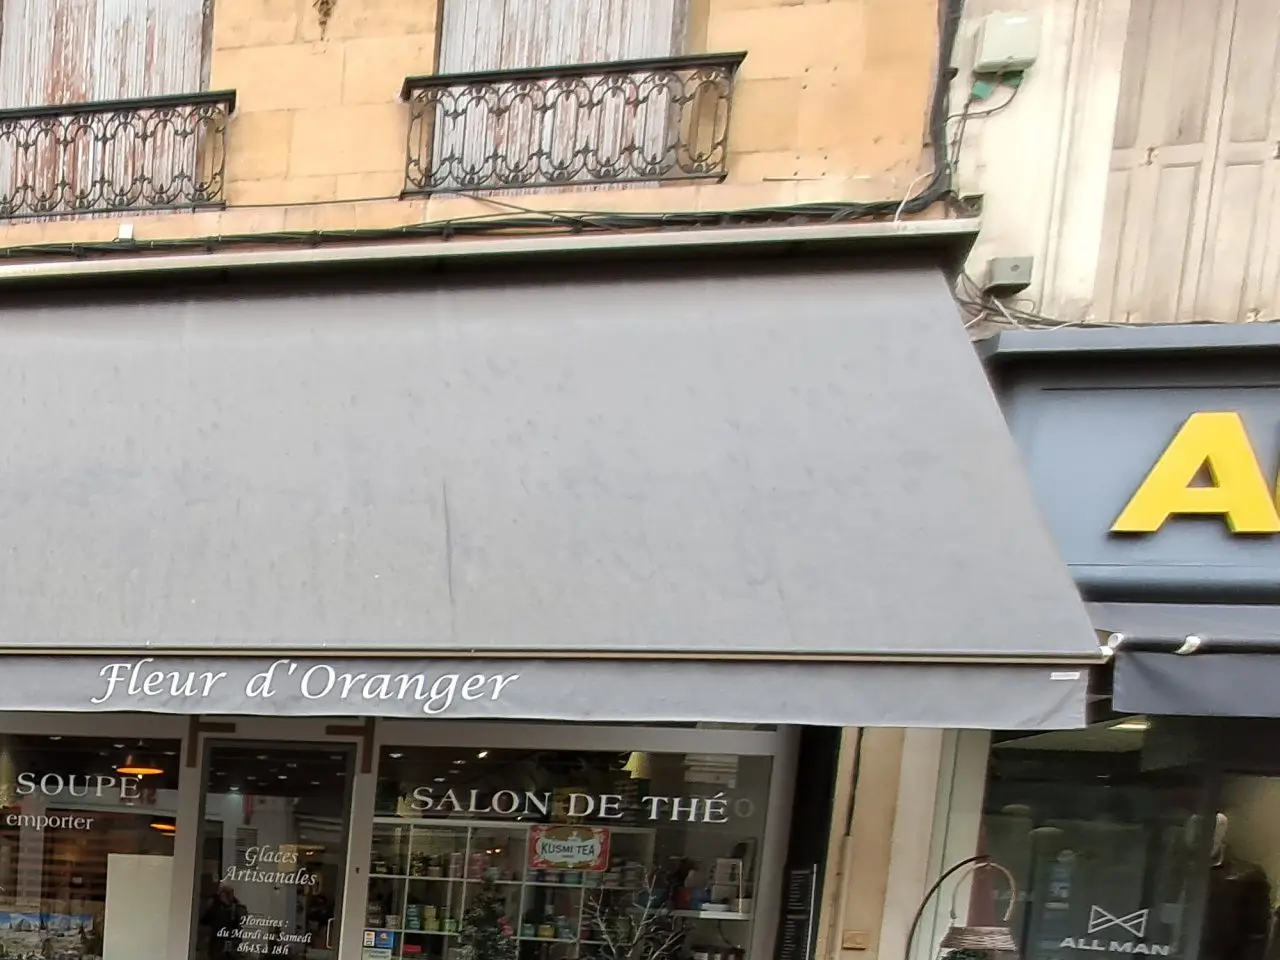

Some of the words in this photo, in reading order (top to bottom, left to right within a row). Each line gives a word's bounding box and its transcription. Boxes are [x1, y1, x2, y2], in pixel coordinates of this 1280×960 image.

[1111, 411, 1280, 533] A
[91, 658, 228, 704] Fleur
[246, 659, 520, 714] d'Oranger
[15, 772, 141, 799] SOUPE
[411, 786, 554, 816] SALON
[566, 793, 623, 819] DE
[641, 792, 730, 823] THÉ
[6, 813, 94, 831] emporter
[244, 844, 298, 866] Glaces
[541, 842, 573, 855] KUSMI
[577, 845, 595, 856] TEA
[220, 865, 317, 885] Artisanales
[240, 915, 282, 927] Horaires
[216, 927, 229, 938] du
[231, 928, 260, 940] Mardi
[262, 933, 274, 941] au
[276, 931, 312, 943] Samedi
[1060, 937, 1105, 951] ALL
[1108, 941, 1170, 956] MAN
